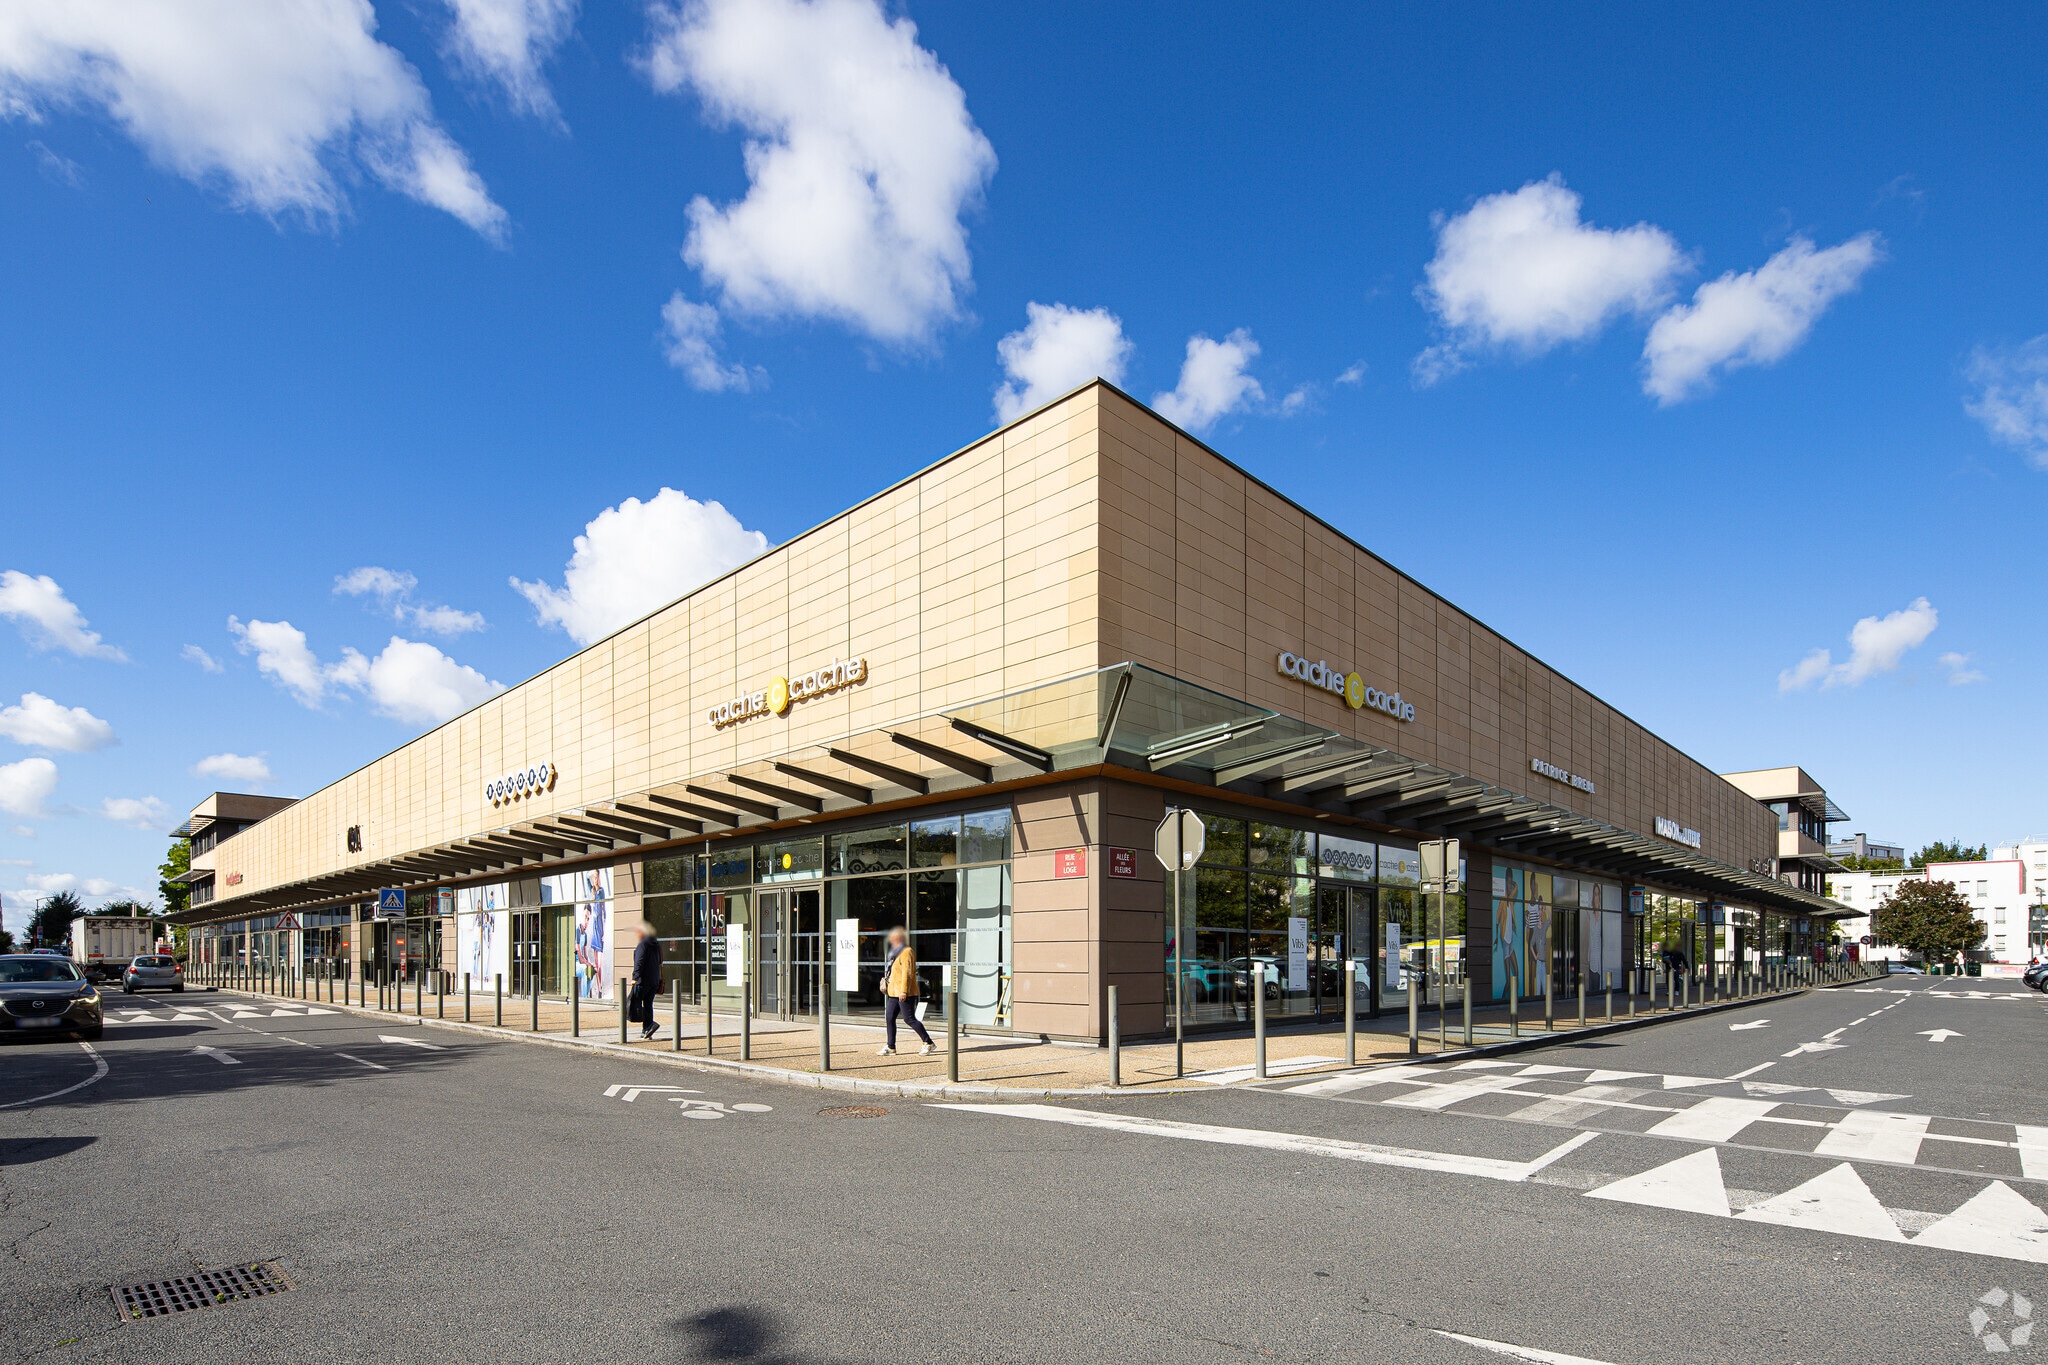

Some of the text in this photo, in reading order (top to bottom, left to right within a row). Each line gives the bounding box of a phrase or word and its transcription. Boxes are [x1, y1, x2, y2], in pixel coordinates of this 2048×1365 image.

[708, 689, 766, 726] cache
[789, 657, 864, 700] cache
[1279, 652, 1345, 694] cache
[1364, 686, 1415, 723] cache
[1533, 758, 1569, 783] PATRICE
[1116, 853, 1130, 861] ALLÉE
[1063, 866, 1077, 874] LOGE
[1114, 866, 1132, 874] FLEURS
[700, 909, 725, 929] Vb's
[1292, 938, 1304, 949] Vib's
